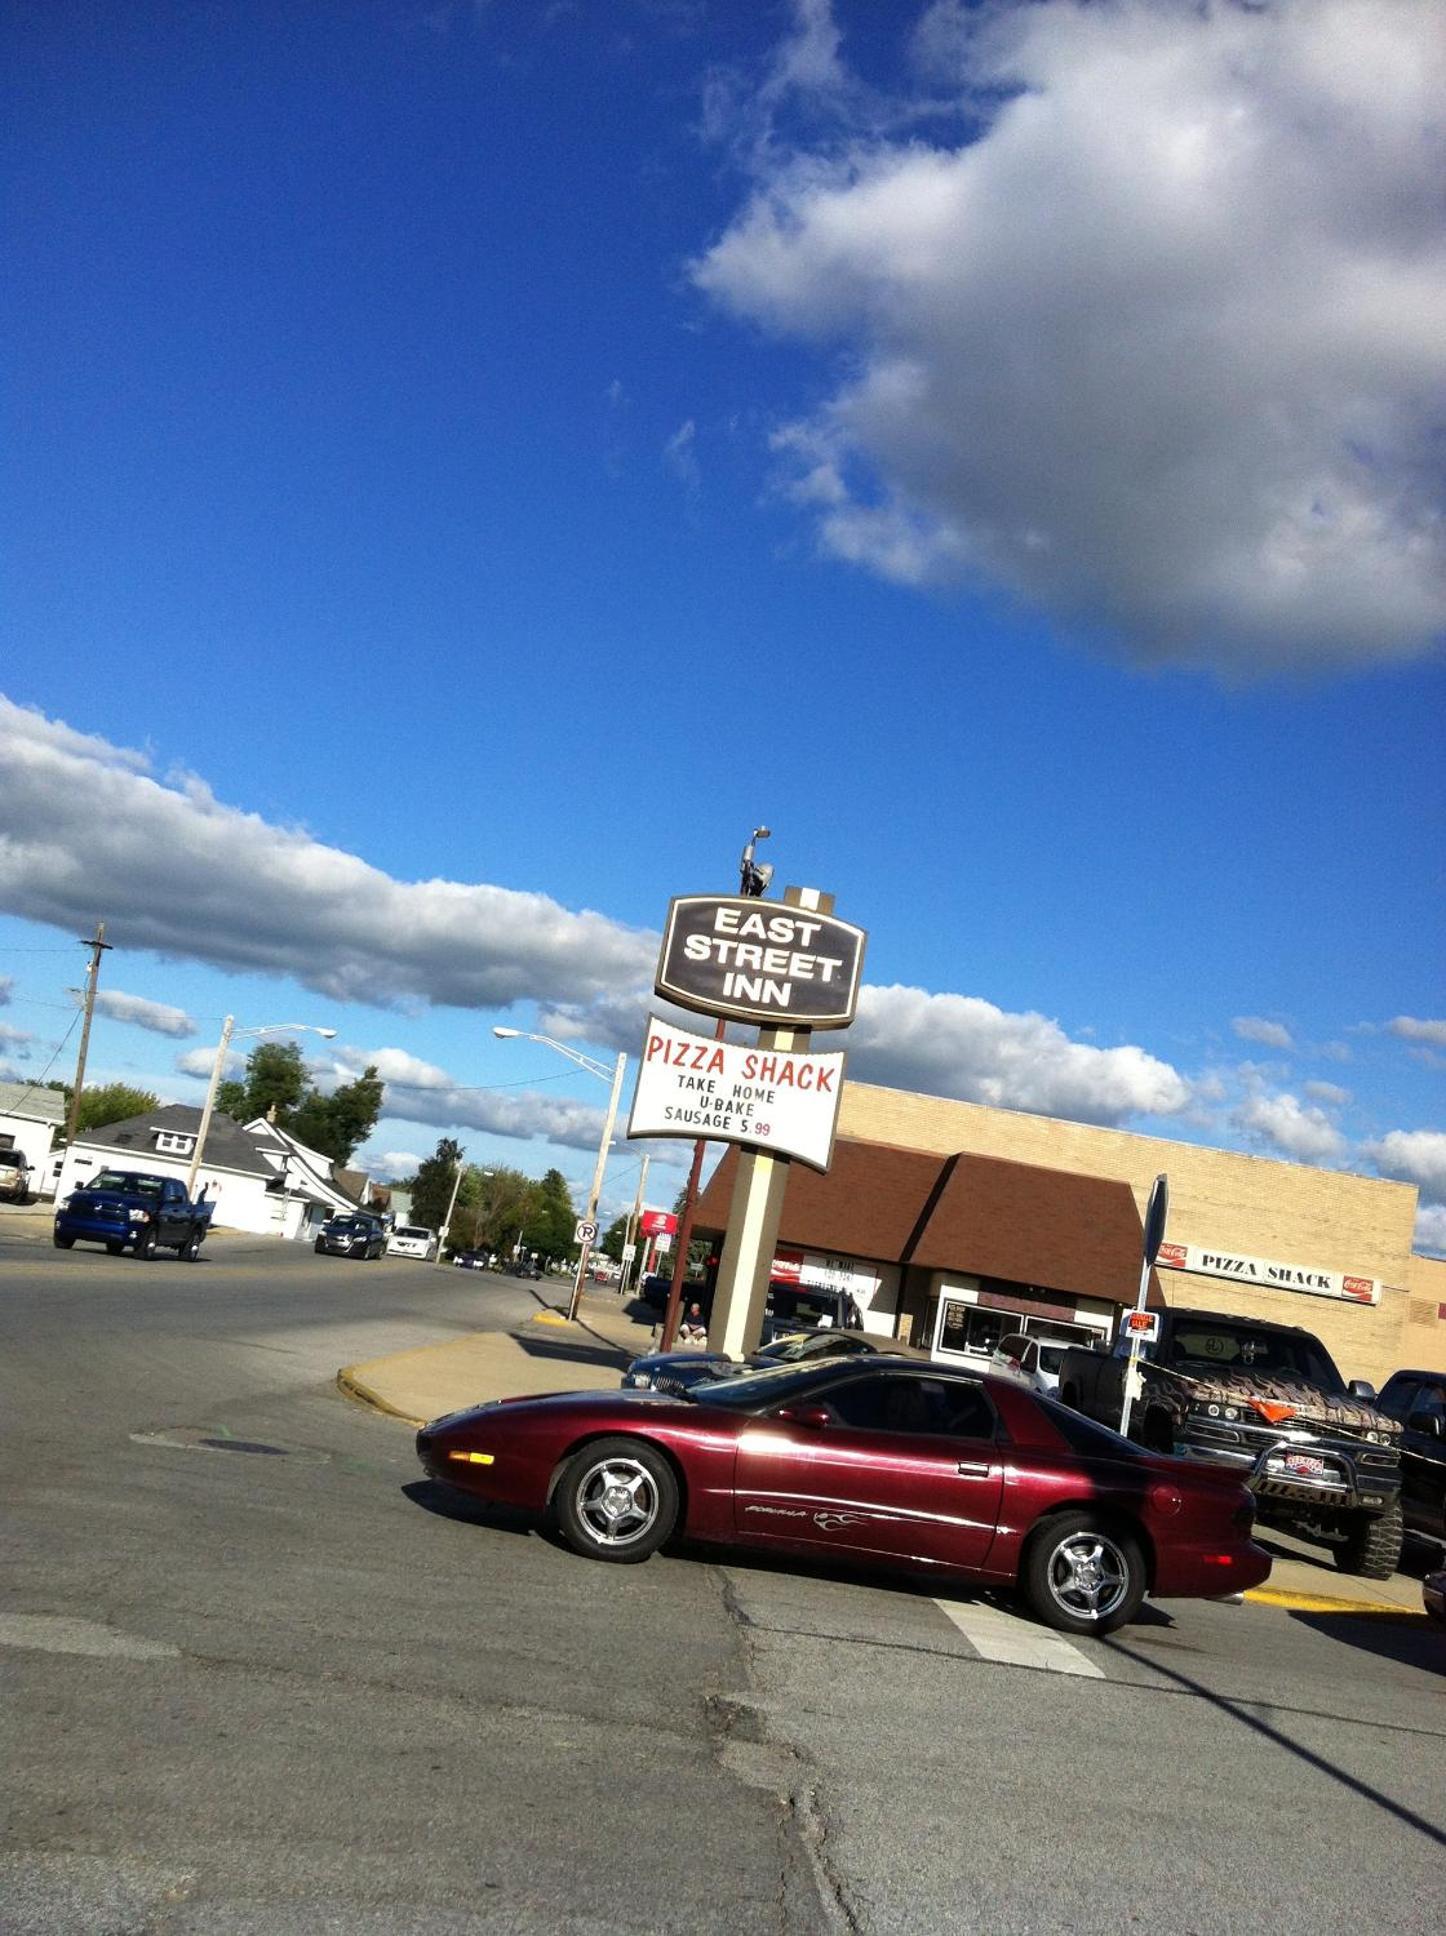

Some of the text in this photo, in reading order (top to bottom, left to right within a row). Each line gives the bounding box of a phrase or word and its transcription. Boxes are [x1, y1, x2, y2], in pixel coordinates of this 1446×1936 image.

[714, 906, 822, 947] EAST
[683, 934, 843, 982] STREET
[722, 972, 792, 1007] INN
[647, 1035, 835, 1092] PIZZA SHACK
[677, 1074, 776, 1104] TAKE HOME
[700, 1095, 755, 1117] U-BAKE
[664, 1106, 731, 1130] SAUSAGE
[1202, 1254, 1331, 1288] PIZZA SHACK
